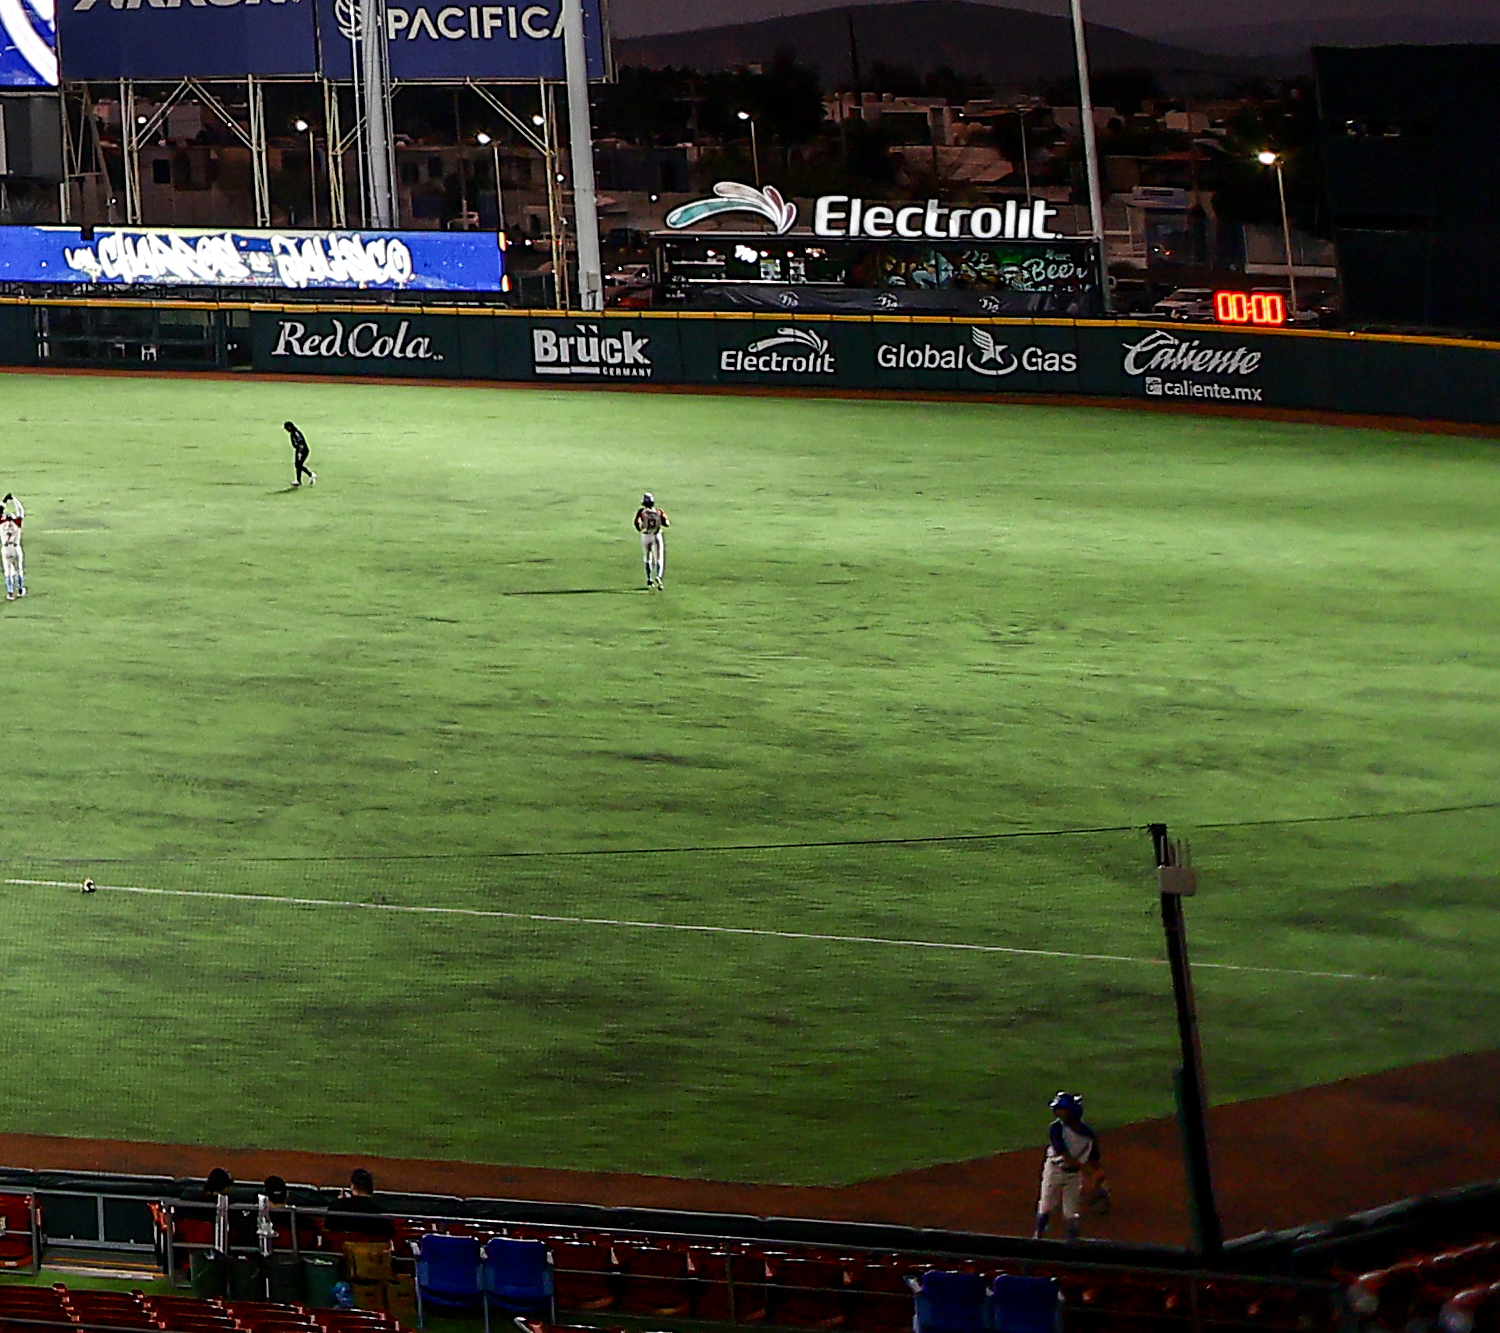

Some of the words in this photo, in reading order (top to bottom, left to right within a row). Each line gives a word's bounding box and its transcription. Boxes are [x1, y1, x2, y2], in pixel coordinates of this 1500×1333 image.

[814, 195, 1058, 239] Electrolit
[1217, 292, 1283, 324] 00:00
[270, 319, 347, 357] Red
[347, 320, 436, 359] Cola
[533, 324, 652, 364] Brück
[1121, 330, 1263, 375] Caliente
[602, 366, 652, 377] GERMANY
[720, 351, 836, 374] Electrolit
[877, 345, 965, 370] Global
[1021, 347, 1078, 372] Gas
[1164, 379, 1263, 402] caliente.mx
